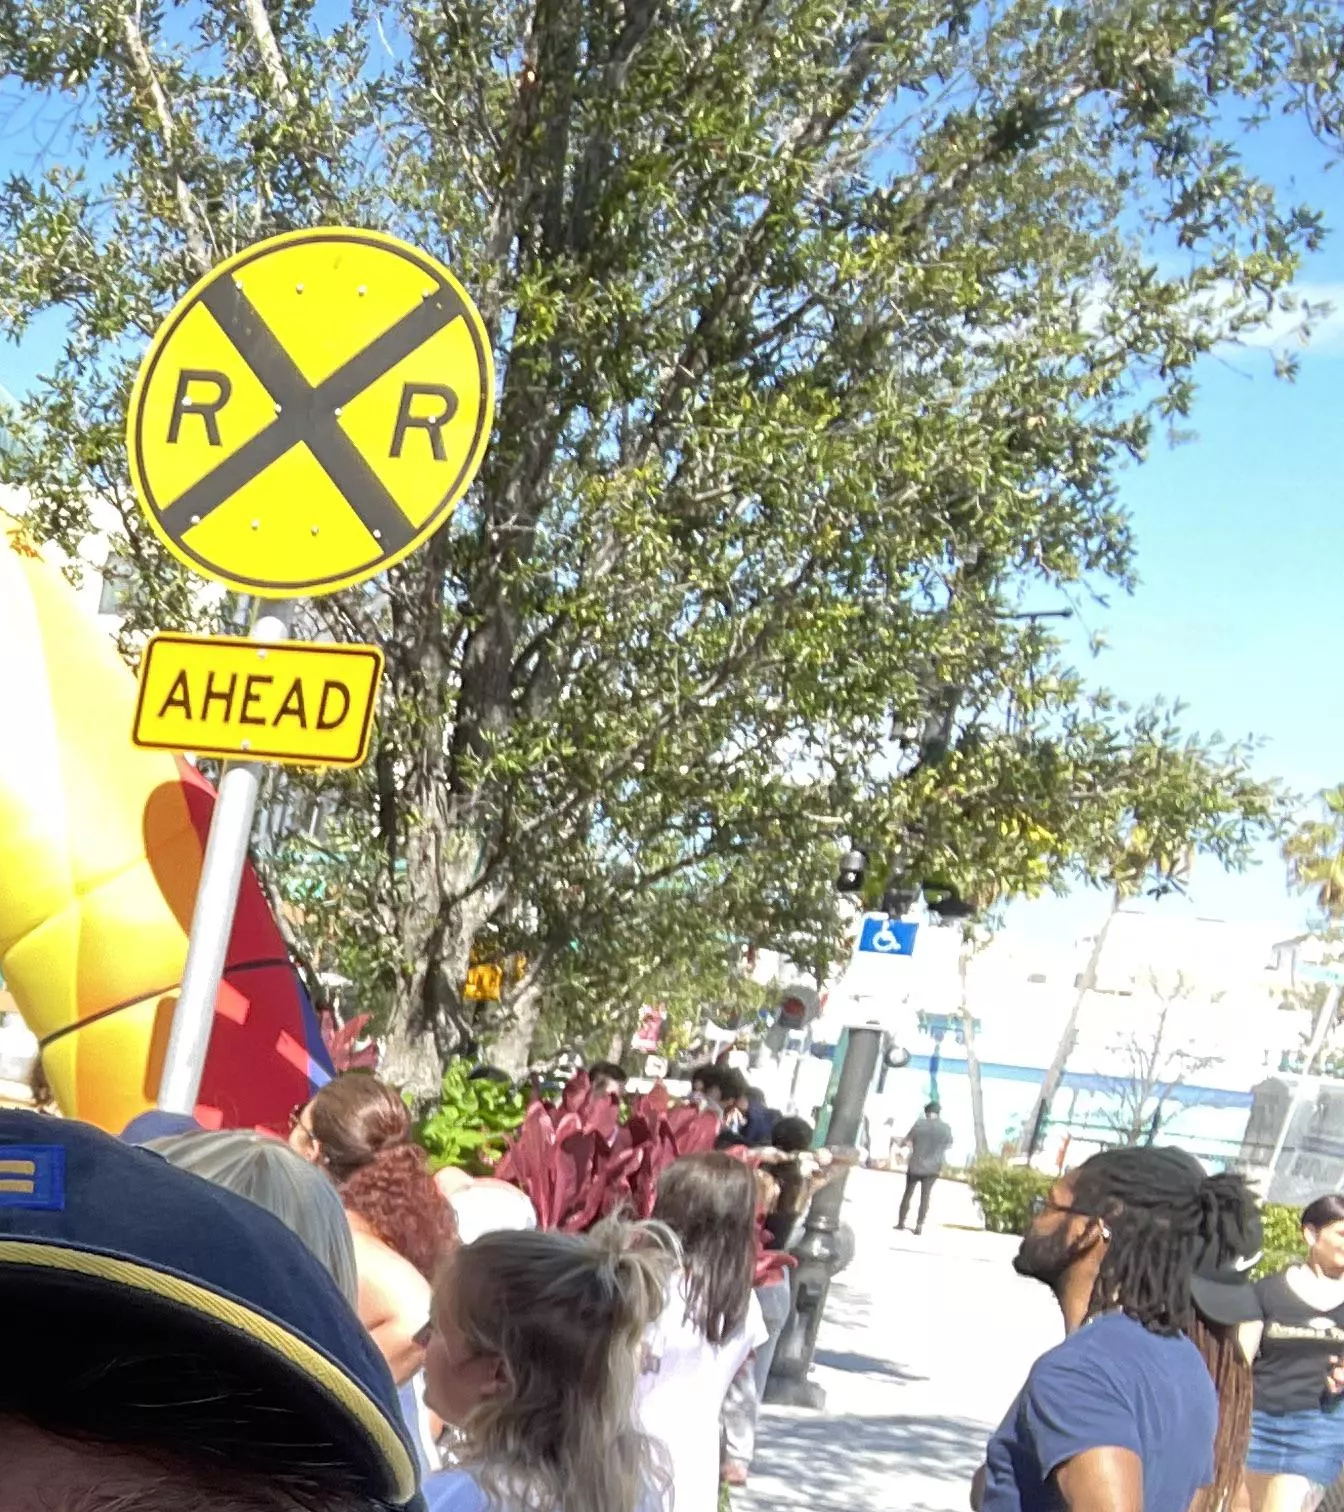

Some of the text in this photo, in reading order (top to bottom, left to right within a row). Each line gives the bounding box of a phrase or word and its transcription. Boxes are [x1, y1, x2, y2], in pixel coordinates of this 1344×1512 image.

[167, 368, 459, 461] R R
[157, 669, 351, 732] AHEAD
